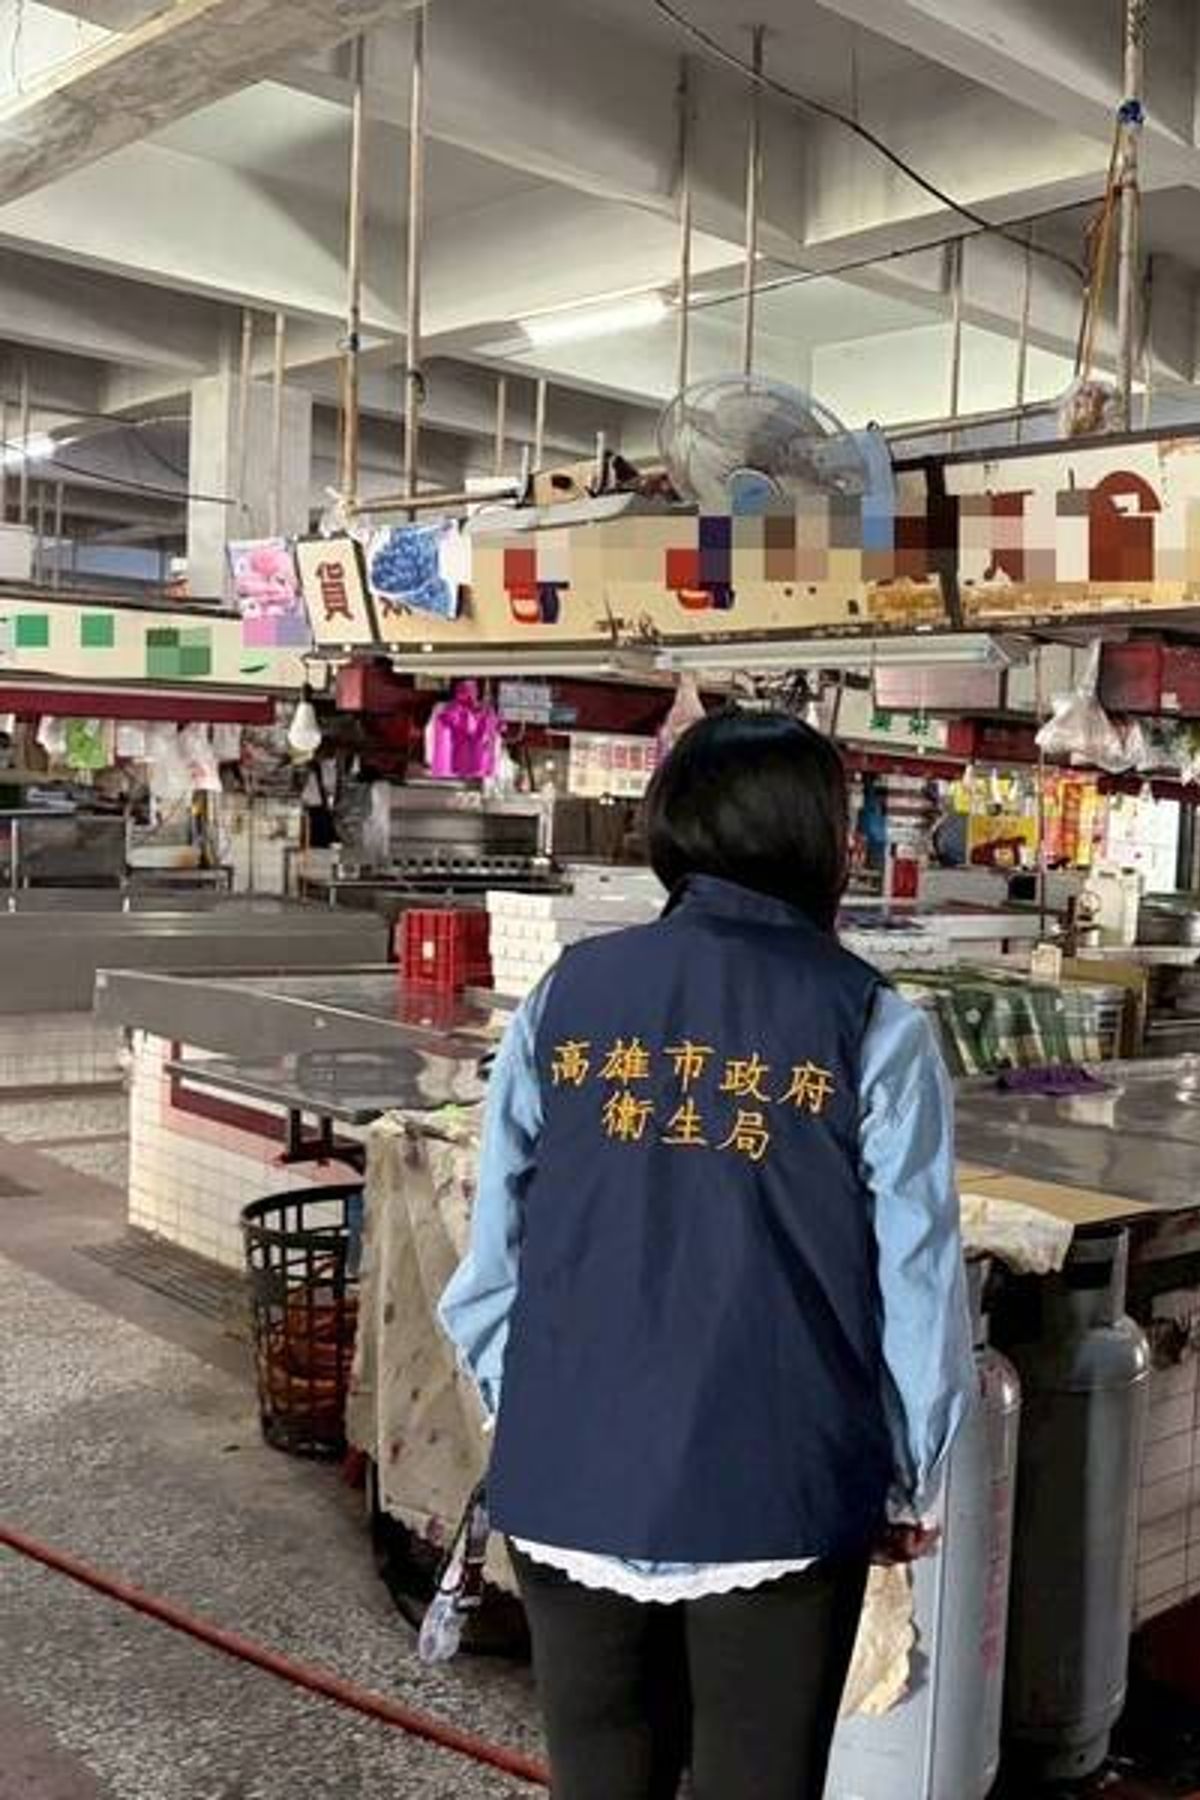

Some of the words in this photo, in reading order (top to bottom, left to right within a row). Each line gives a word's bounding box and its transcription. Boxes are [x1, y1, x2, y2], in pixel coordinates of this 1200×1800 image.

[550, 1036, 836, 1114] 高雄市政府
[601, 1088, 771, 1162] 衛生局
